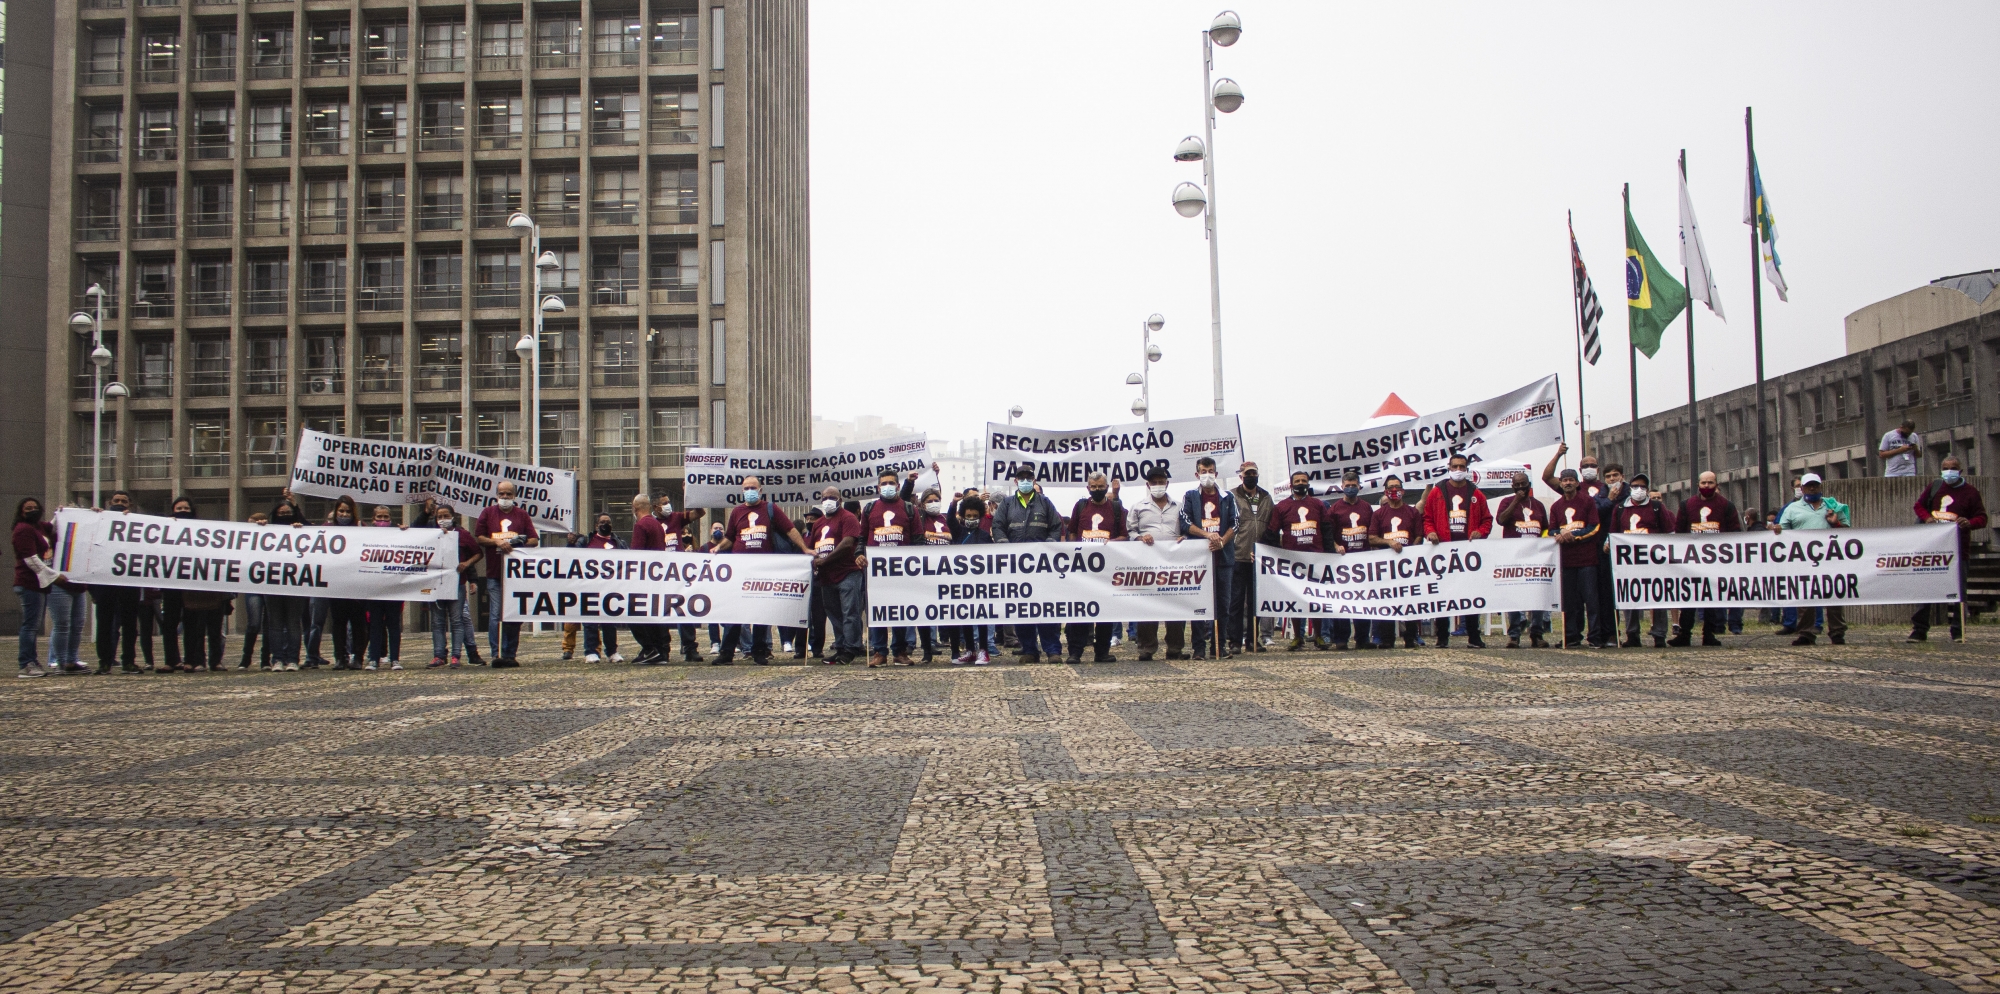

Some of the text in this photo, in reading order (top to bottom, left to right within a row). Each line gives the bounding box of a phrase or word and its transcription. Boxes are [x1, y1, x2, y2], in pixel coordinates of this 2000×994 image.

[1498, 403, 1555, 428] SINDSERV
[889, 441, 926, 454] SINDSERV
[992, 428, 1174, 455] RECLASSIFICAÇÃO
[1183, 440, 1237, 454] SINDSERV
[1293, 412, 1489, 466] RECLASSIFICAÇÃO
[437, 446, 499, 476] GANHAM
[504, 466, 554, 486] MENOS
[685, 455, 728, 463] SINDSERV
[730, 448, 885, 470] RECLASSIFICAÇÃO DOS
[294, 468, 390, 494] VALORIZAÇÃO
[395, 480, 403, 493] E
[317, 455, 335, 470] DE
[340, 458, 363, 473] UM
[369, 461, 432, 477] SALÁRIO
[436, 465, 492, 491] MÍNIMO
[787, 474, 805, 485] DE
[809, 467, 873, 485] MÁQUINA
[771, 492, 808, 503] LUTA,
[108, 520, 346, 558] RECLASSIFICAÇÃO
[360, 548, 434, 565] SINDSERV
[1616, 535, 1864, 567] RECLASSIFICAÇÃO
[1876, 554, 1954, 568] SINDSERV
[111, 552, 241, 582] SERVENTE
[248, 560, 328, 588] GERAL
[507, 558, 733, 587] RECLASSIFICAÇÃO
[871, 547, 1105, 579] RECLASSIFICAÇÃO
[1260, 548, 1482, 585] RECLASSIFICAÇÃO
[1493, 567, 1556, 579] SINDSERV
[742, 581, 809, 594] SINDSERV
[1111, 569, 1207, 586] SINDSERV
[1617, 573, 1859, 603] MOTORISTA PARAMENTADOR
[938, 582, 1033, 600] PEDREIRO
[1302, 582, 1439, 600] ALMOXARIFE E
[512, 592, 712, 617] TAPECEIRO
[872, 601, 1100, 621] MEIO OFICIAL PEDREIRO
[1260, 597, 1487, 617] AUX. DE ALMOXARIFADO
